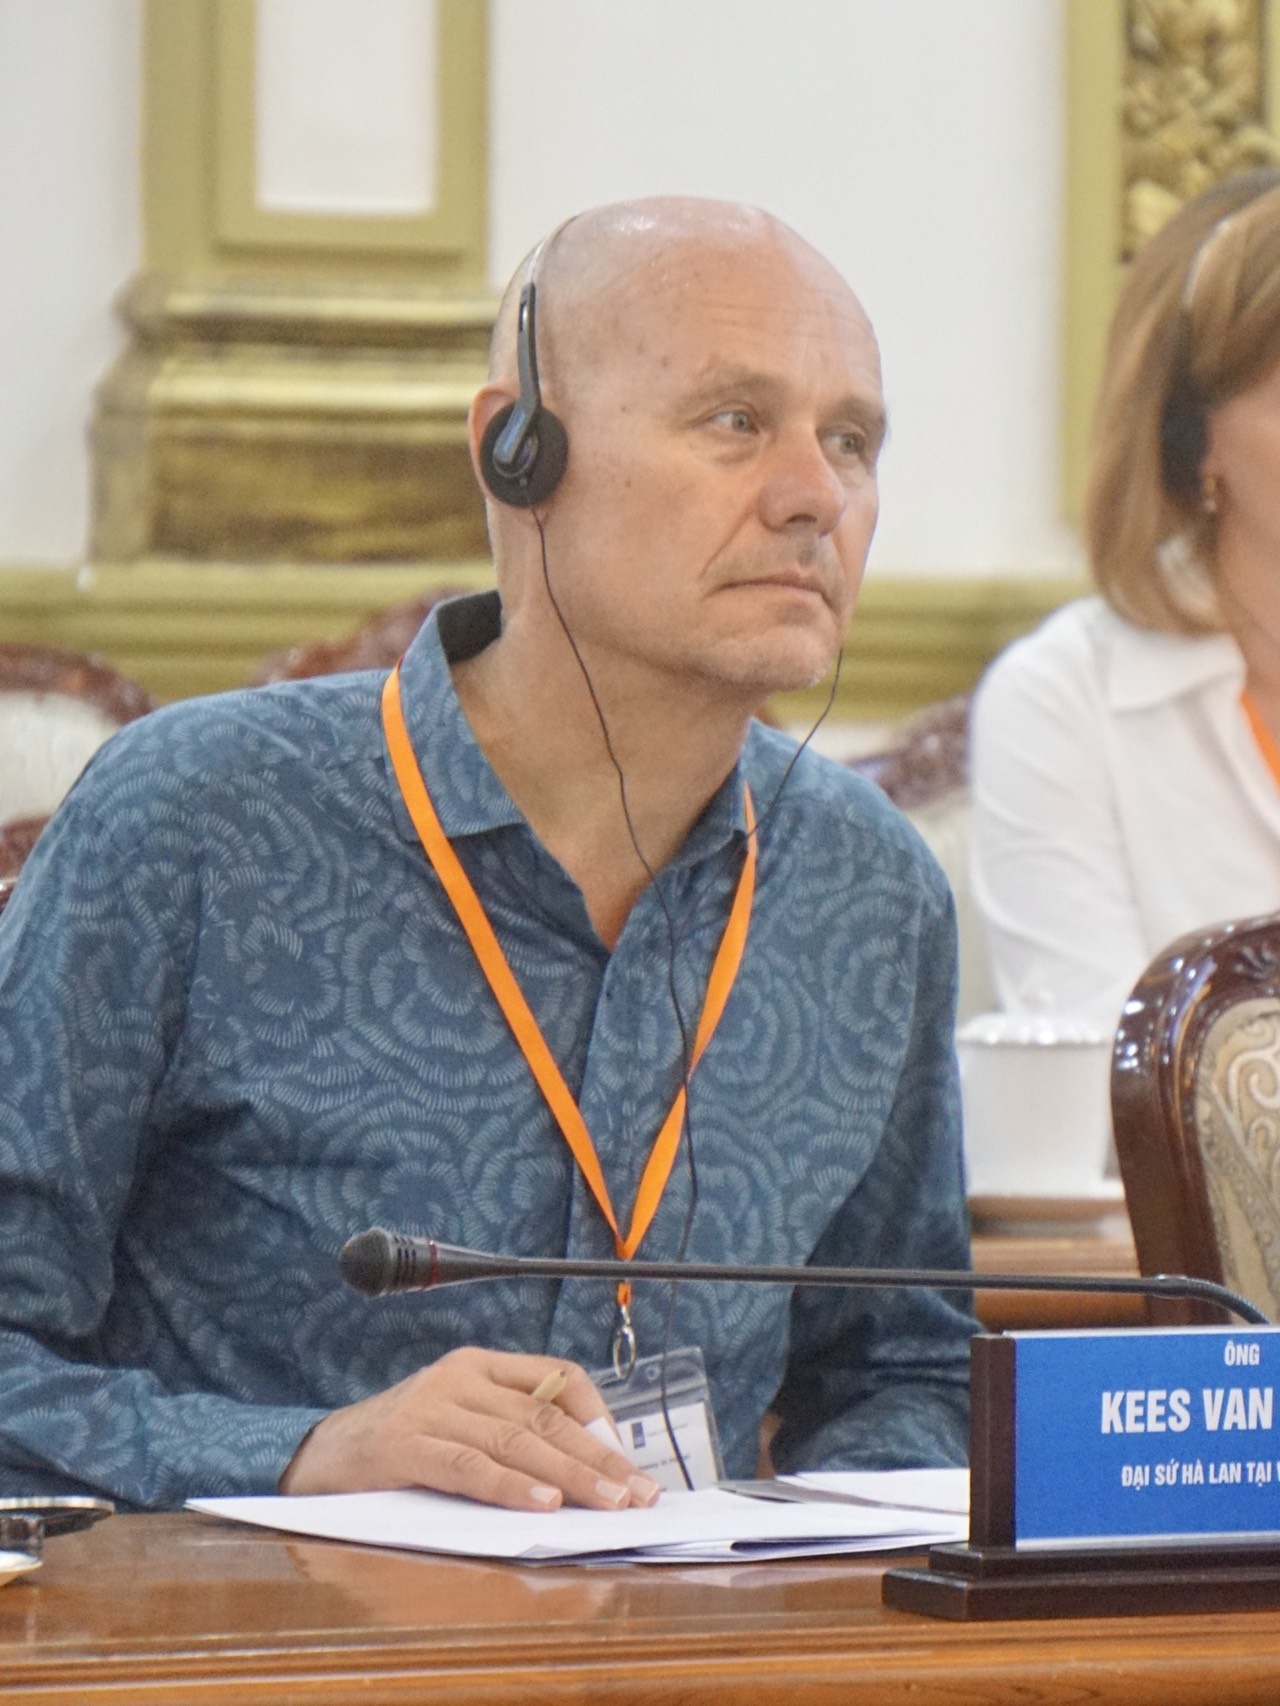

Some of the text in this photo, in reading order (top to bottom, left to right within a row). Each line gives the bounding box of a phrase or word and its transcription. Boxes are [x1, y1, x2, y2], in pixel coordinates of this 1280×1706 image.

[1224, 1340, 1260, 1366] ÔNG
[1101, 1388, 1191, 1434] KEES
[1202, 1387, 1274, 1431] VAN
[1121, 1465, 1150, 1491] ĐẠI
[1154, 1459, 1180, 1486] SỨ
[1182, 1459, 1205, 1485] HÀ
[1209, 1462, 1242, 1484] LAN
[1246, 1462, 1272, 1487] TẠI
